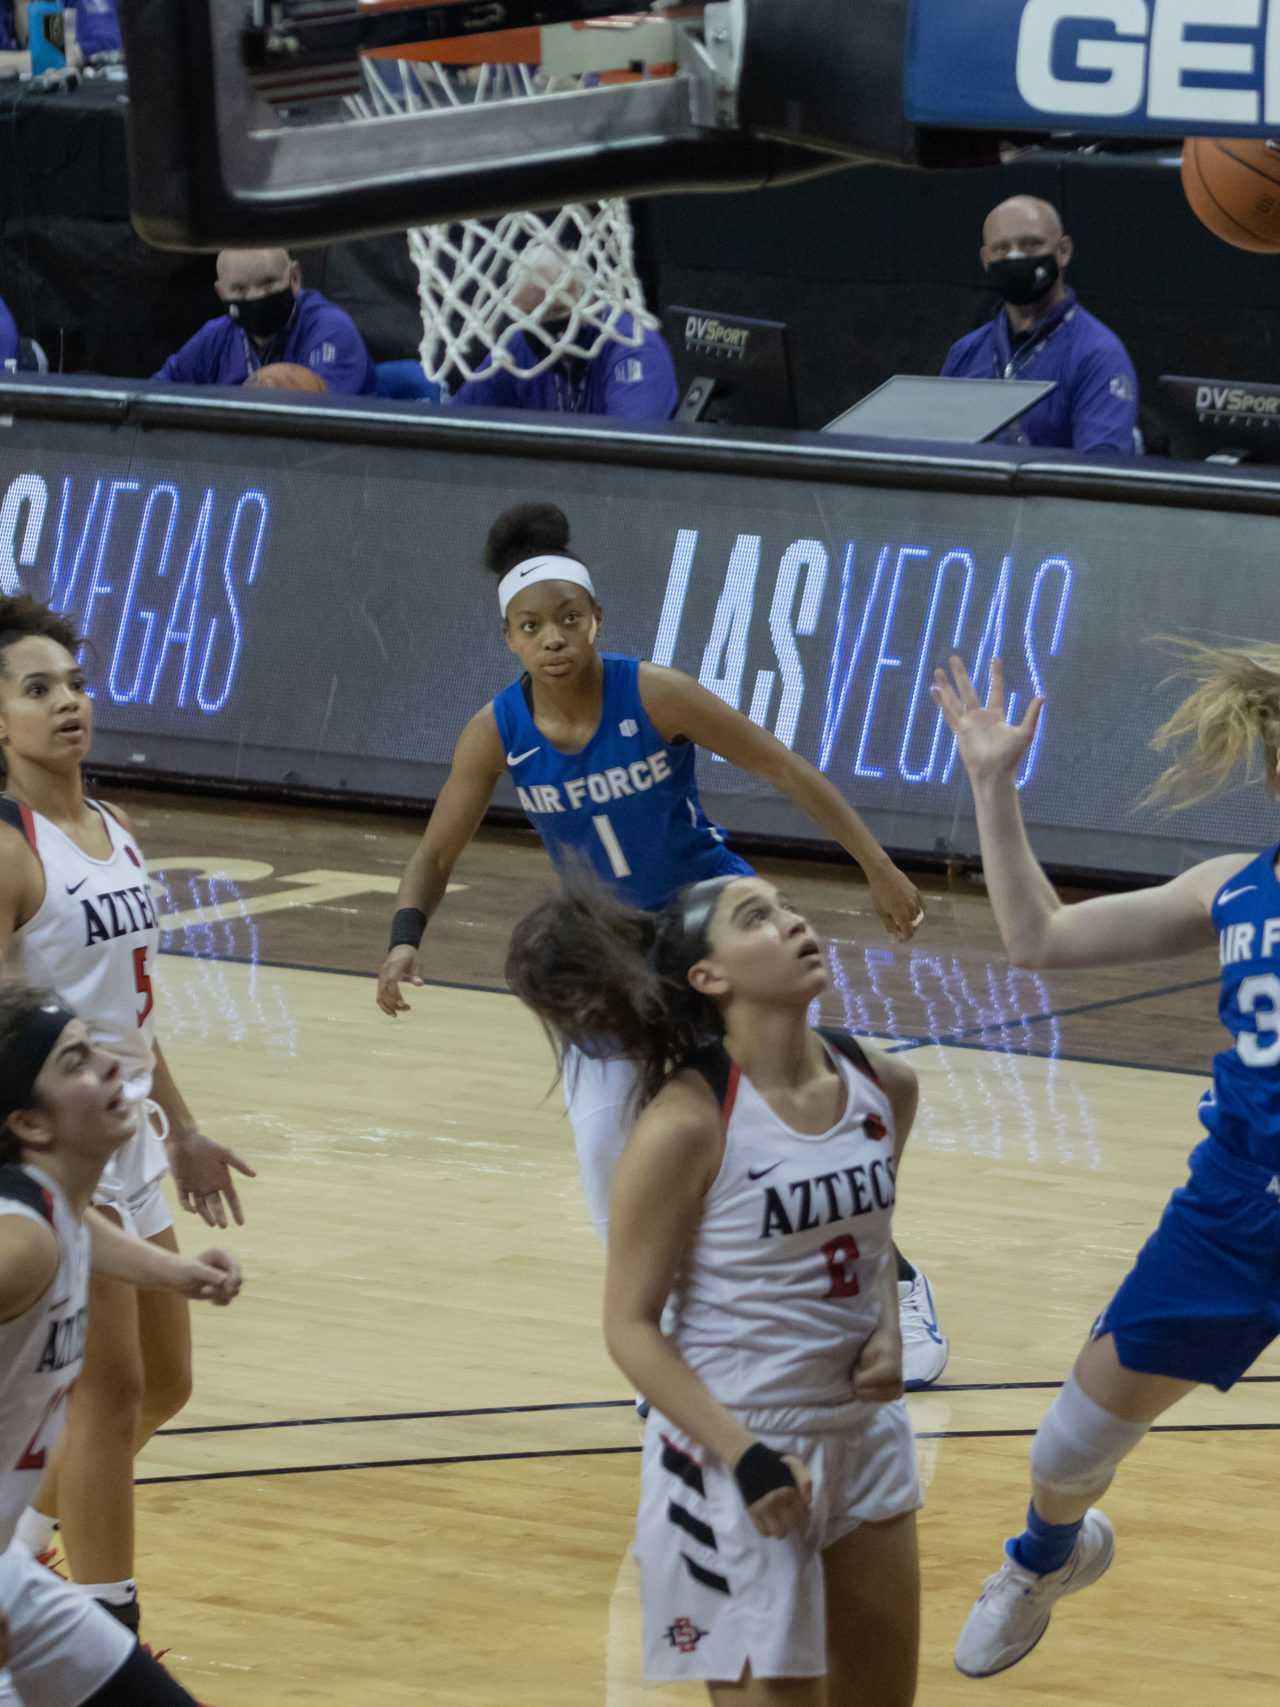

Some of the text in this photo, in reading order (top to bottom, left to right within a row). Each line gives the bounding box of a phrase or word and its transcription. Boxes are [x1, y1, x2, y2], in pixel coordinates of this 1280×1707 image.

[48, 475, 269, 713] VEGAS
[818, 536, 1074, 791] VEGAS
[516, 750, 673, 813] AIR FORCE
[591, 814, 632, 878] 1
[132, 946, 154, 1028] 5
